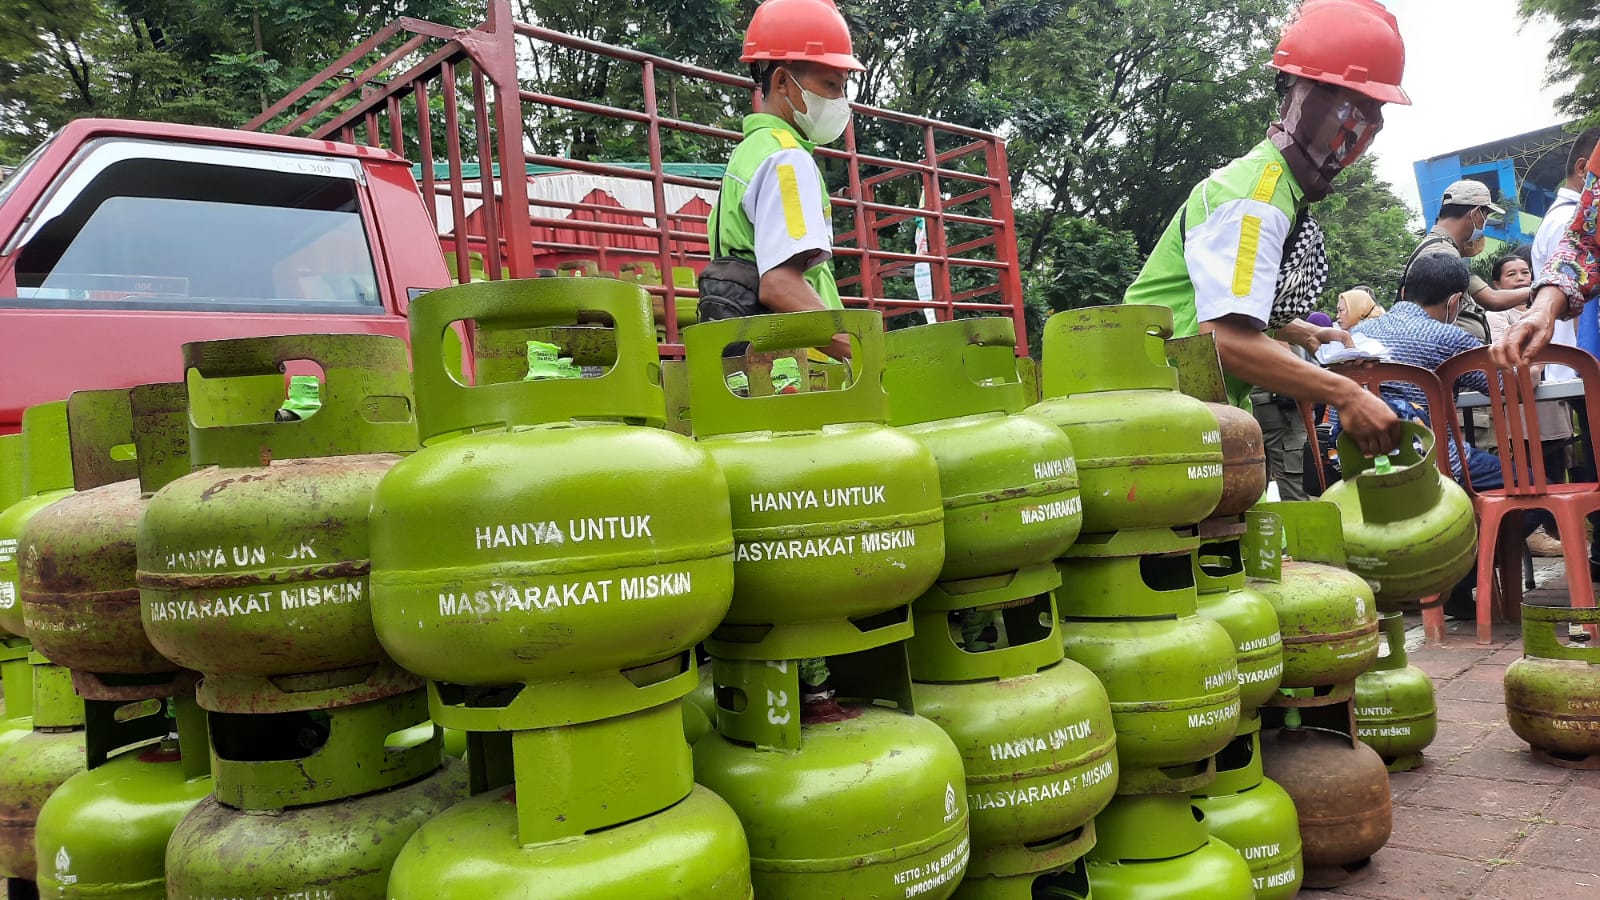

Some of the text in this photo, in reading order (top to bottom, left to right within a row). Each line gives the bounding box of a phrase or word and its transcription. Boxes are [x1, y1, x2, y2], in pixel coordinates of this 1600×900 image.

[310, 164, 331, 174] 300
[1033, 459, 1063, 479] HANYA
[750, 485, 886, 513] HANYA UNTUK
[475, 515, 652, 550] HANYA UNTUK
[733, 529, 915, 562] ASYARAKAT MISKIN
[150, 581, 363, 622] MASYARAKAT MISKIN
[438, 572, 692, 617] MASYARAKAT MISKIN
[1204, 671, 1232, 690] HANYA
[767, 689, 791, 725] 23
[1361, 706, 1393, 716] UNTUK
[990, 719, 1092, 760] HANYA UNTUK
[1357, 726, 1411, 737] KAT MISKIN
[967, 759, 1113, 810] MASYARAKAT MISKIN
[1245, 843, 1280, 860] UNTUK
[894, 867, 920, 886] NETTO
[925, 863, 930, 875] 3
[931, 861, 940, 874] Kg
[905, 873, 947, 899] DIPRODUKSI
[1267, 867, 1296, 888] MISKIN
